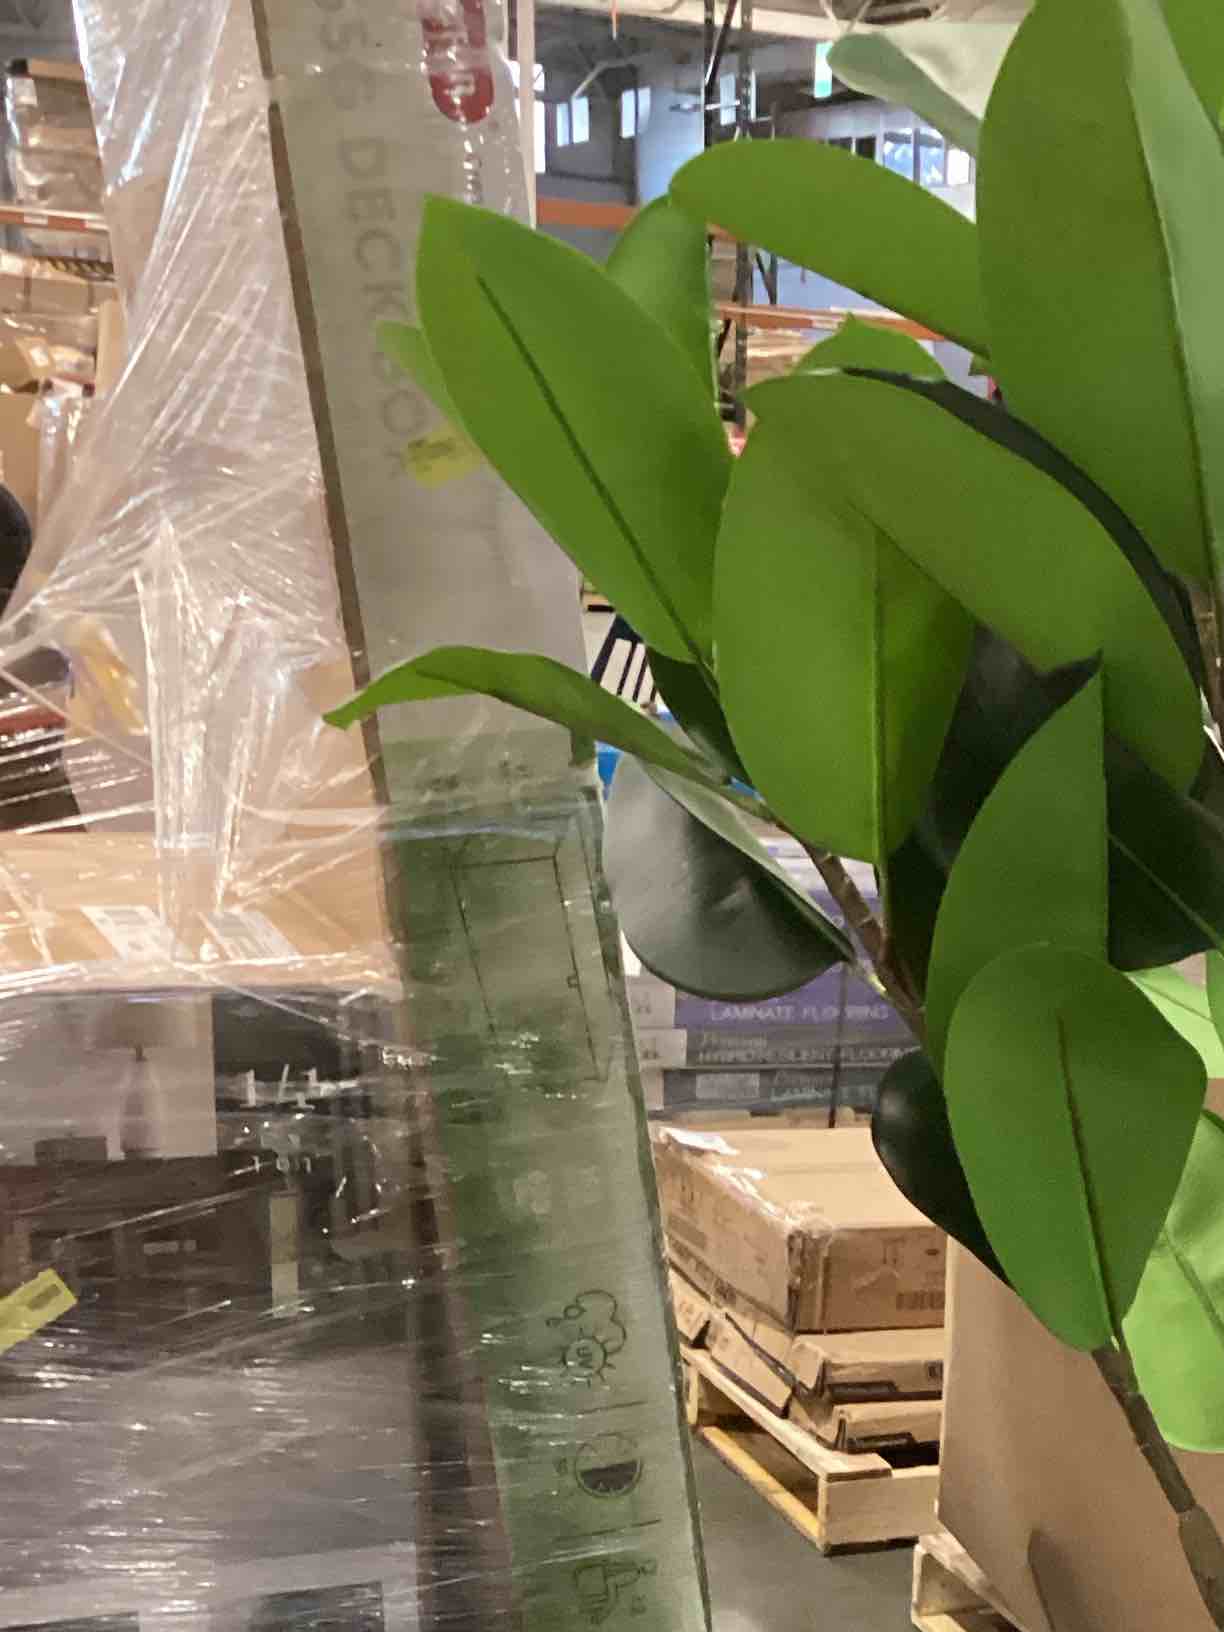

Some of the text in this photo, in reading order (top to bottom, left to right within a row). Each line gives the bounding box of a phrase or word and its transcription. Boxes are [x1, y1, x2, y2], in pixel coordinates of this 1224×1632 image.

[337, 135, 407, 323] DECK
[710, 1003, 889, 1022] LAMINATE FLORING
